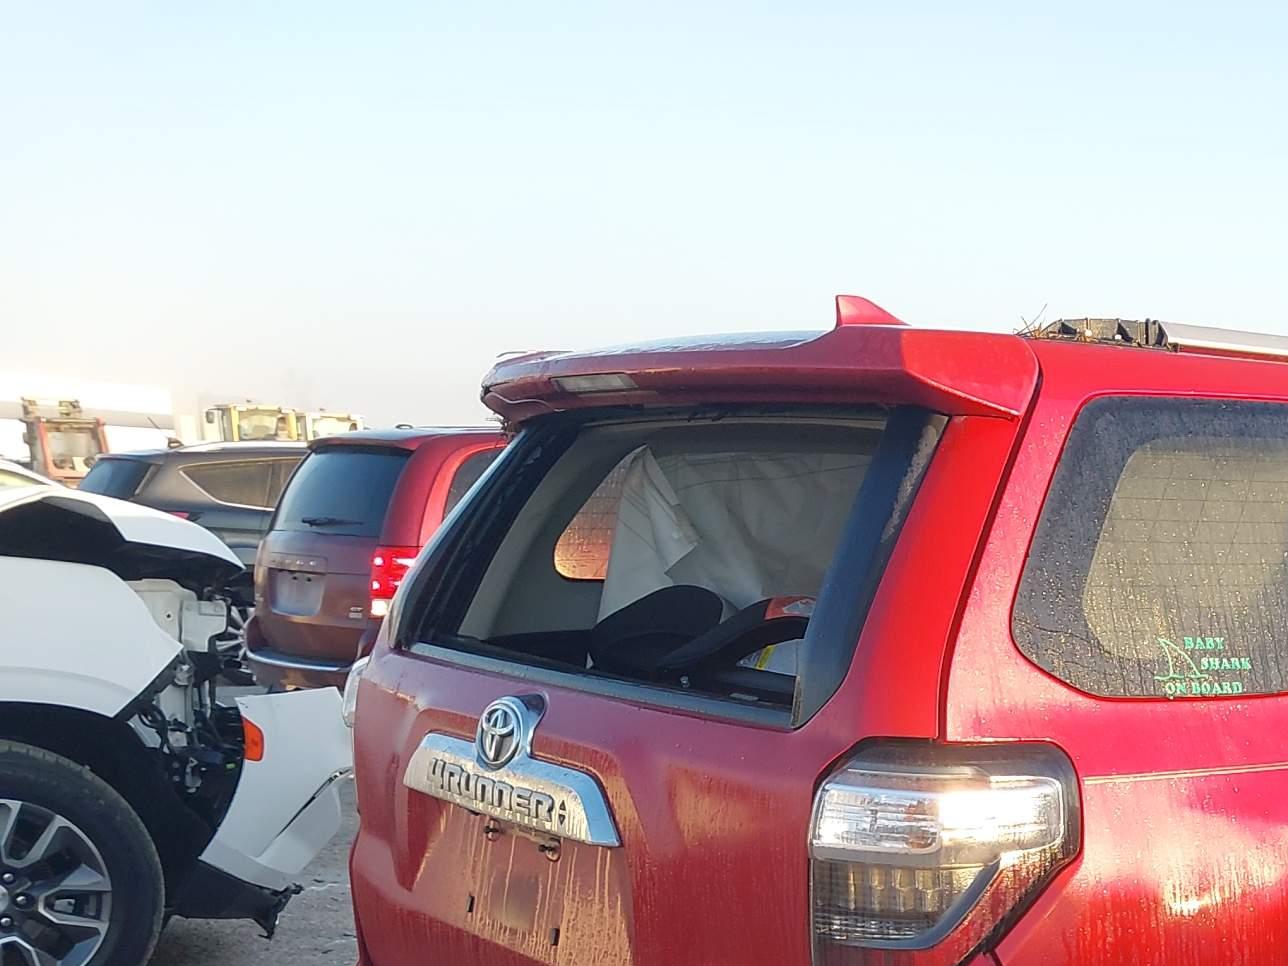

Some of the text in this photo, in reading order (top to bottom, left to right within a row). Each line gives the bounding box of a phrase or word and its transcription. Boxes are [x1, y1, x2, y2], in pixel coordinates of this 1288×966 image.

[1183, 636, 1224, 650] BABY
[1200, 657, 1252, 671] SHARK
[1165, 681, 1243, 695] ON BOARD
[427, 757, 556, 821] 4RUNNER
